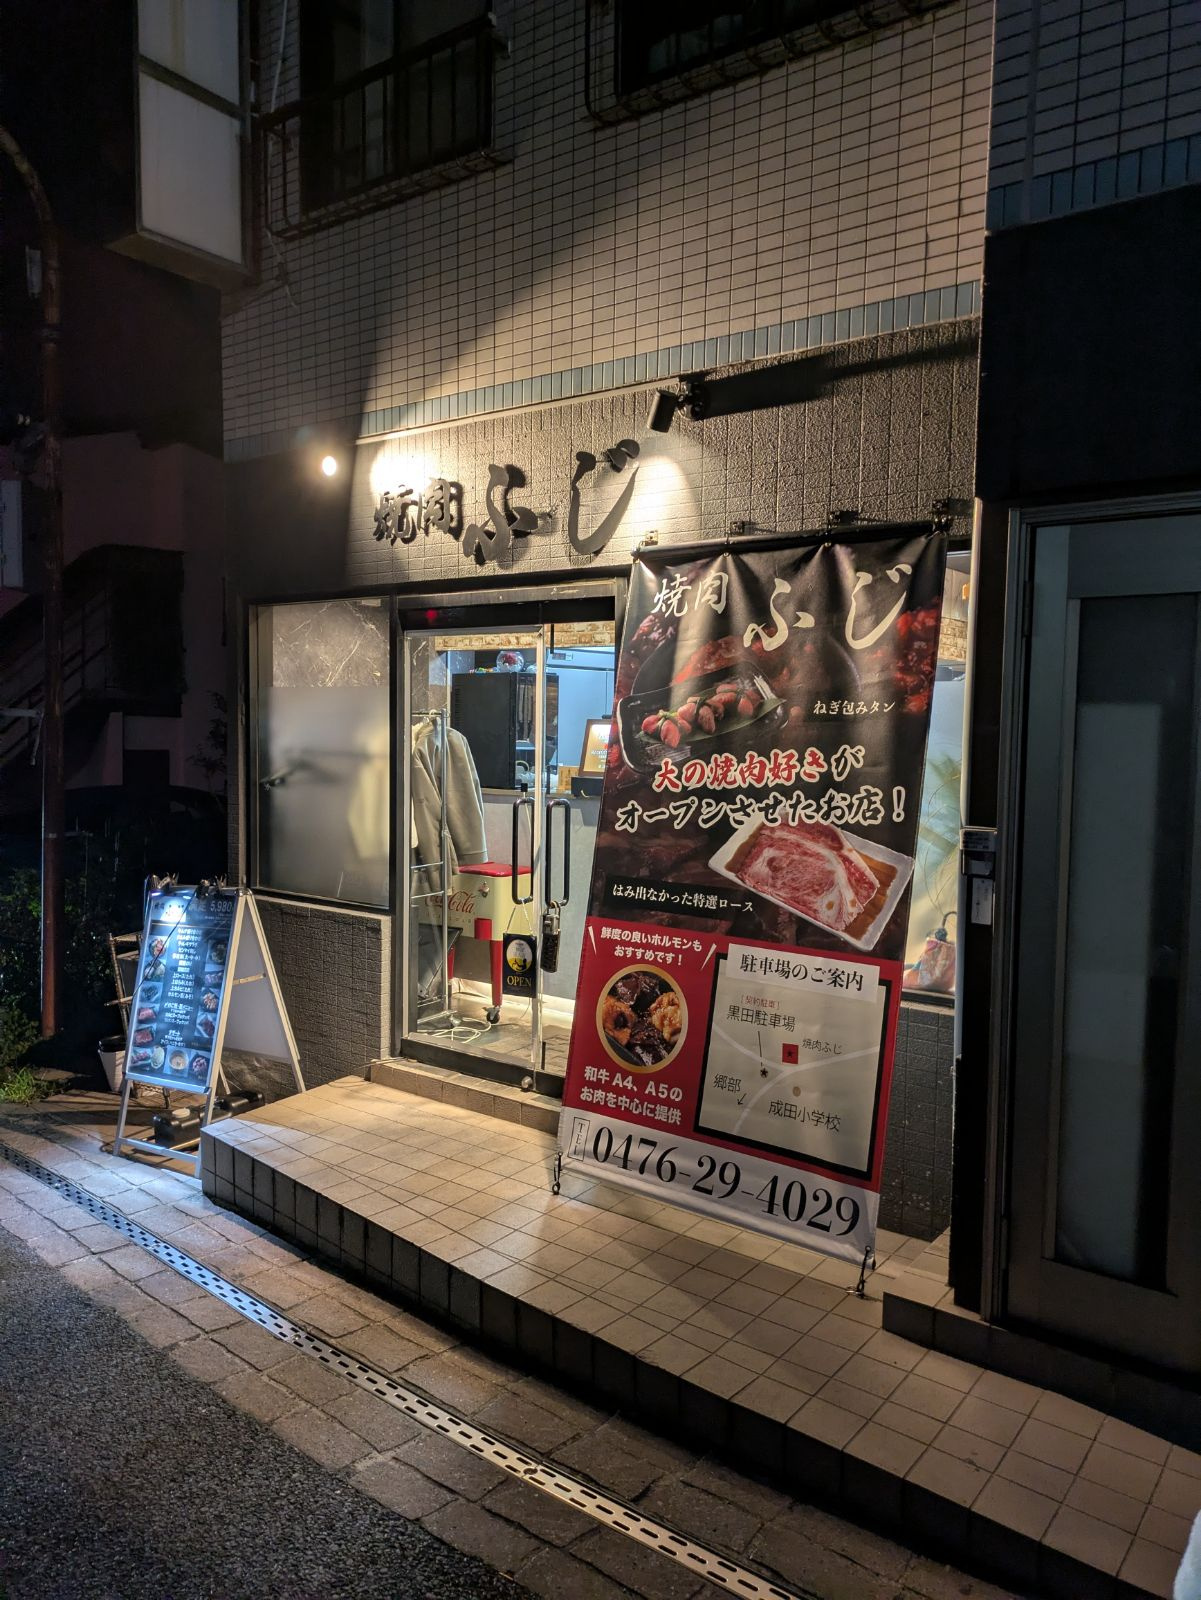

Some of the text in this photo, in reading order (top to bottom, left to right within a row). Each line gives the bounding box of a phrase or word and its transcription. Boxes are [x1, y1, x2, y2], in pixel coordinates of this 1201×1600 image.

[813, 699, 896, 716] ねぎ包みタン
[652, 745, 866, 792] 大の焼肉好きが
[615, 786, 906, 833] オープンさせたお店！
[612, 883, 753, 913] はみ出なかった特選ロース
[600, 926, 703, 952] 鮮度の良いホルモンも
[614, 945, 683, 966] おすすめです！
[506, 975, 532, 987] OPEN
[739, 953, 865, 992] 駐車場のご案内
[726, 1004, 796, 1033] 黒田駐車場
[801, 1038, 843, 1055] 焼肉ふじ
[713, 1073, 742, 1093] 郷部
[580, 1086, 682, 1125] お肉を中心に提供
[768, 1100, 842, 1132] 成田小学校
[592, 1126, 861, 1238] 0476-29-4029
